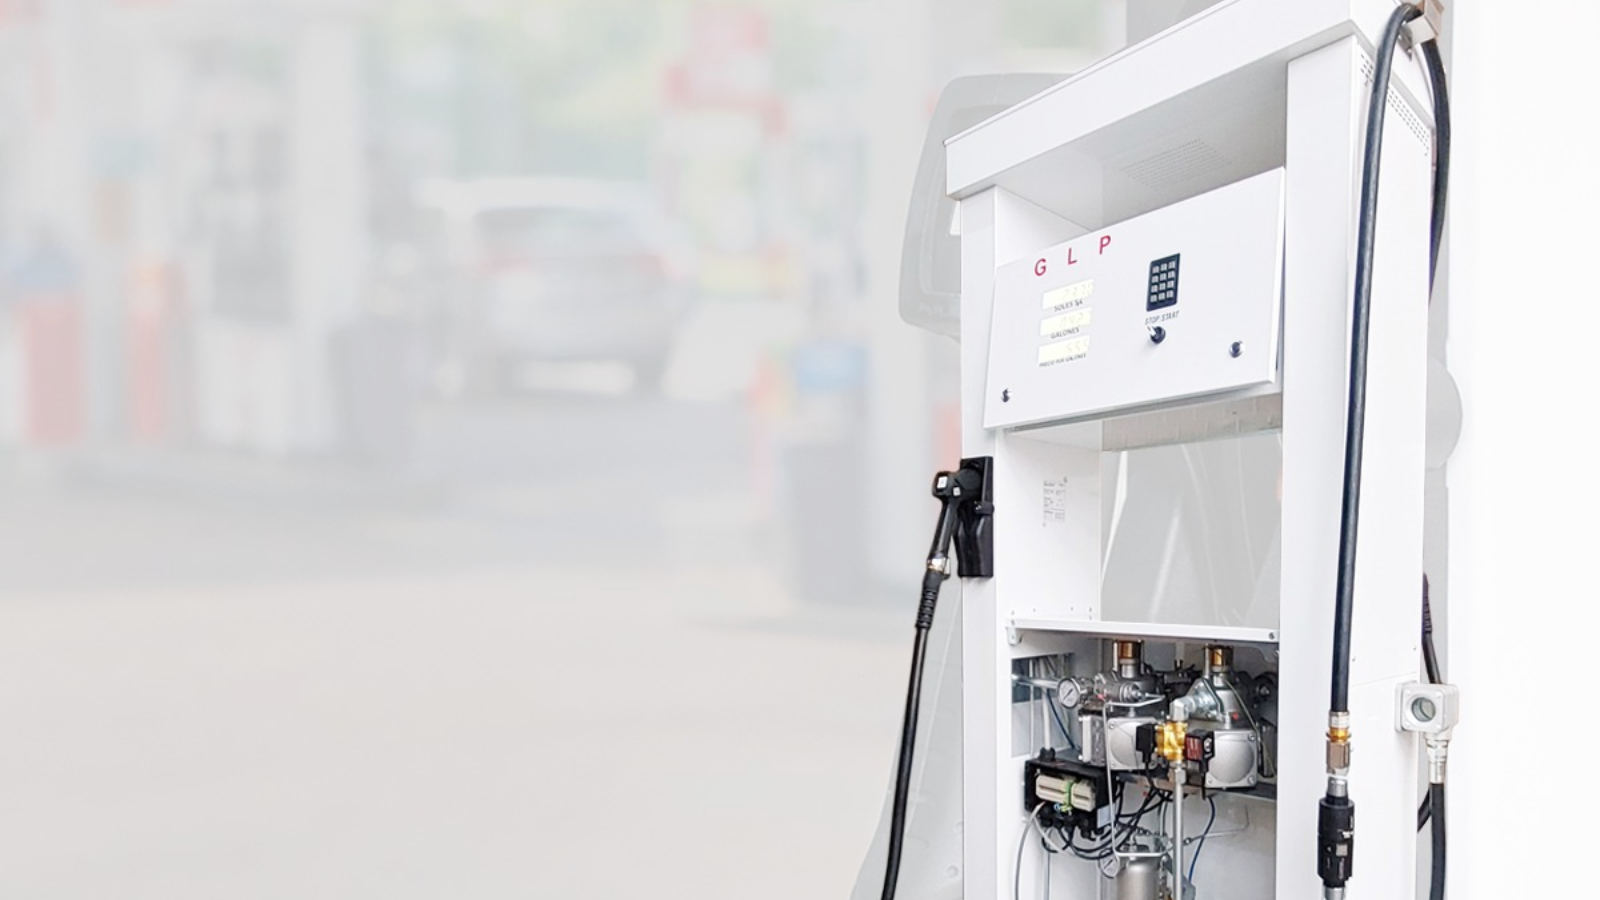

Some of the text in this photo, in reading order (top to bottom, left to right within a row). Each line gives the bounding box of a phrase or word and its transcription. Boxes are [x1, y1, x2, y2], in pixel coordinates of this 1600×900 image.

[1034, 235, 1111, 276] G L P
[1054, 301, 1073, 312] SOLES
[1145, 310, 1180, 325] STOP START
[1050, 326, 1080, 339] GALONES
